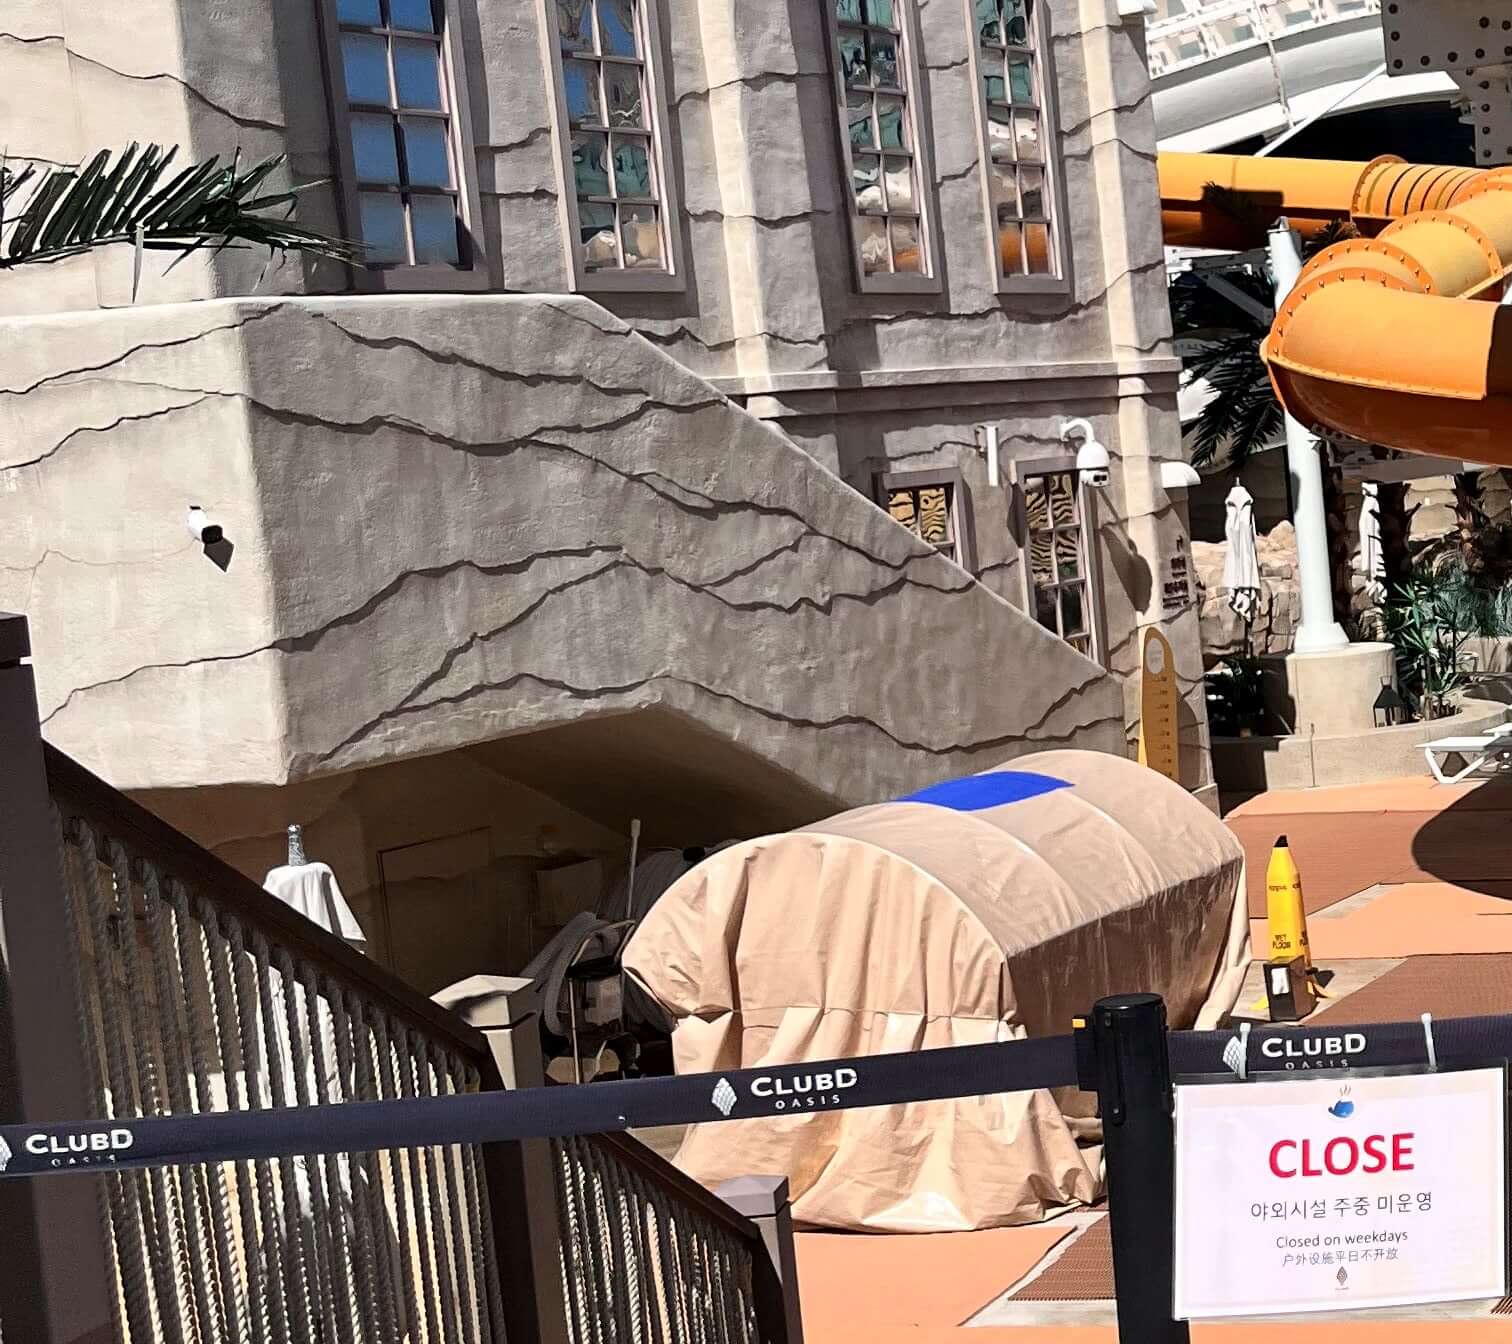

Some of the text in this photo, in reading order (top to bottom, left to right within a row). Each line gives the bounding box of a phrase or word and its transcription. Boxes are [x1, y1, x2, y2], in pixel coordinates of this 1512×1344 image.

[1261, 1033, 1366, 1058] CLUBD
[750, 1068, 858, 1096] CLUBD
[775, 1094, 840, 1110] OASIS
[25, 1128, 134, 1154] CLUBD
[1269, 1132, 1415, 1178] CLOSE
[1250, 1191, 1432, 1221] 야외시설 주중 미운영
[1276, 1230, 1408, 1249] Closed on weekdays
